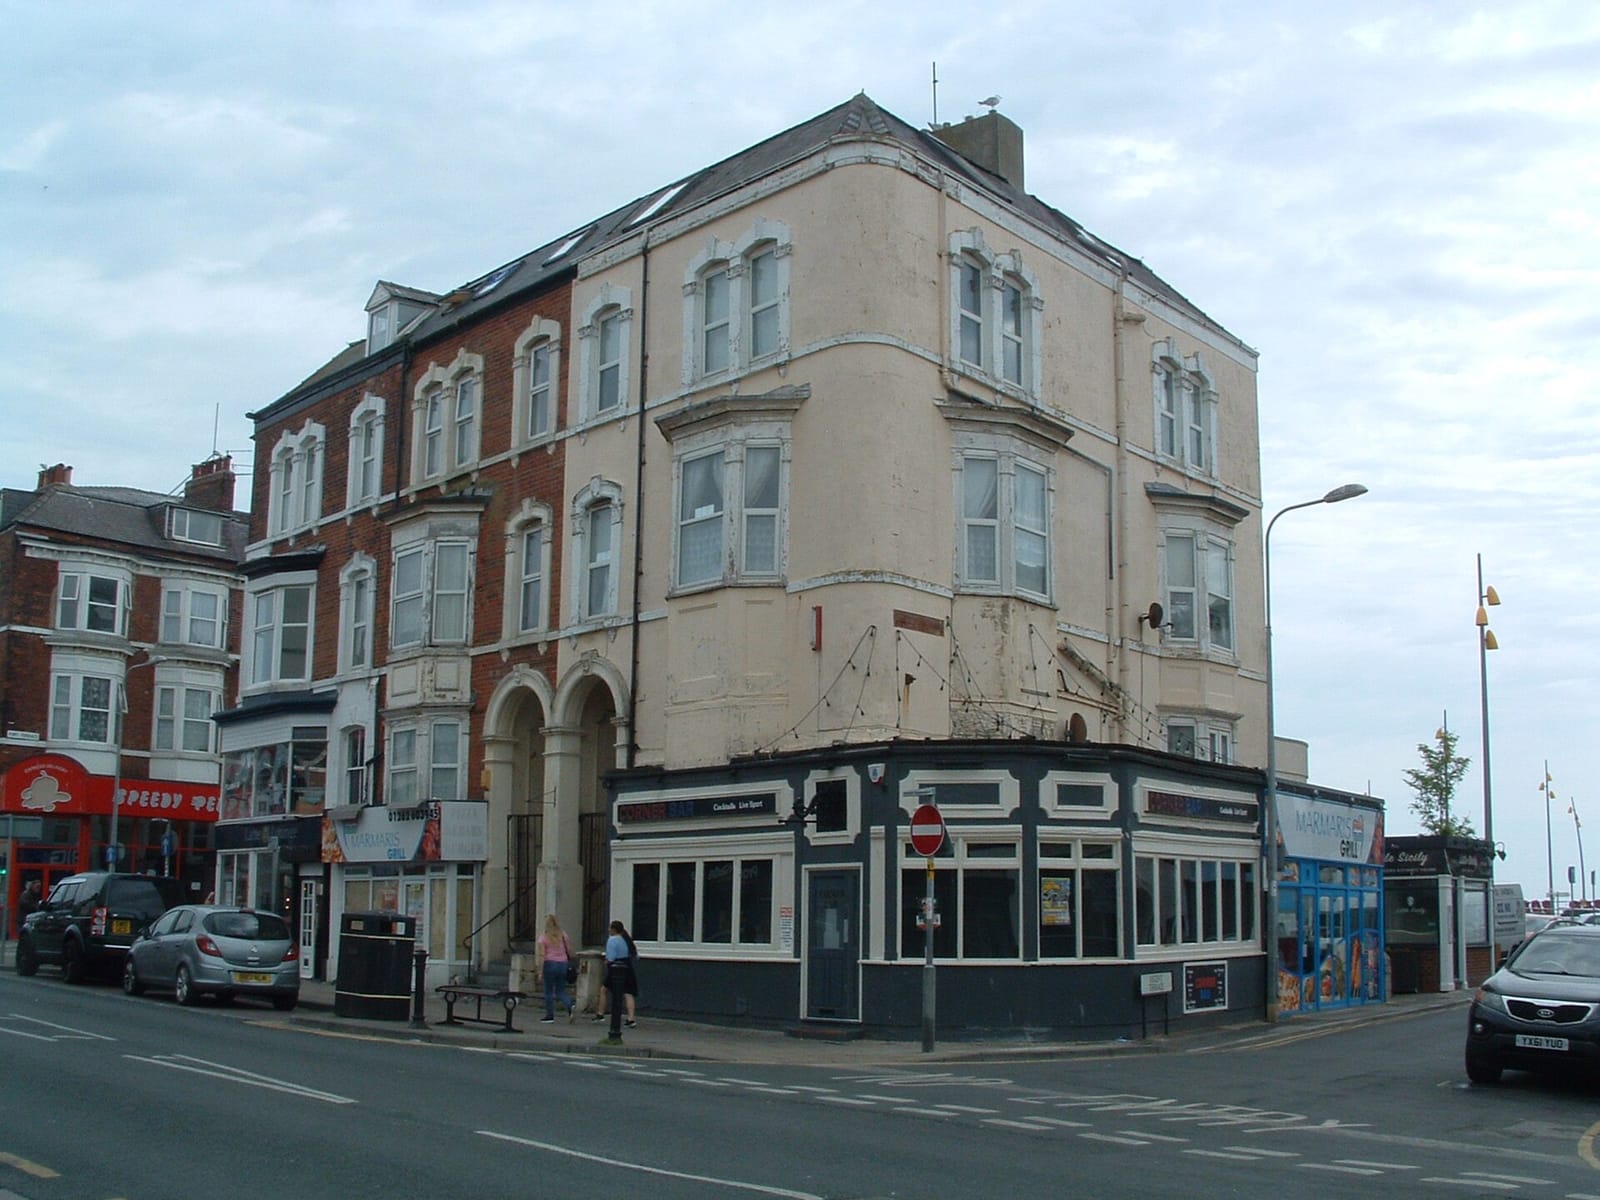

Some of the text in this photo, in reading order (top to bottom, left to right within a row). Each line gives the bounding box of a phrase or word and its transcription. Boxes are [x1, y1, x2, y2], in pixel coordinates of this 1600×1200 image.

[113, 788, 183, 809] SPEEDY
[1296, 810, 1352, 840] MARMARIS
[387, 848, 406, 860] GRILL
[1340, 839, 1358, 859] GRILL
